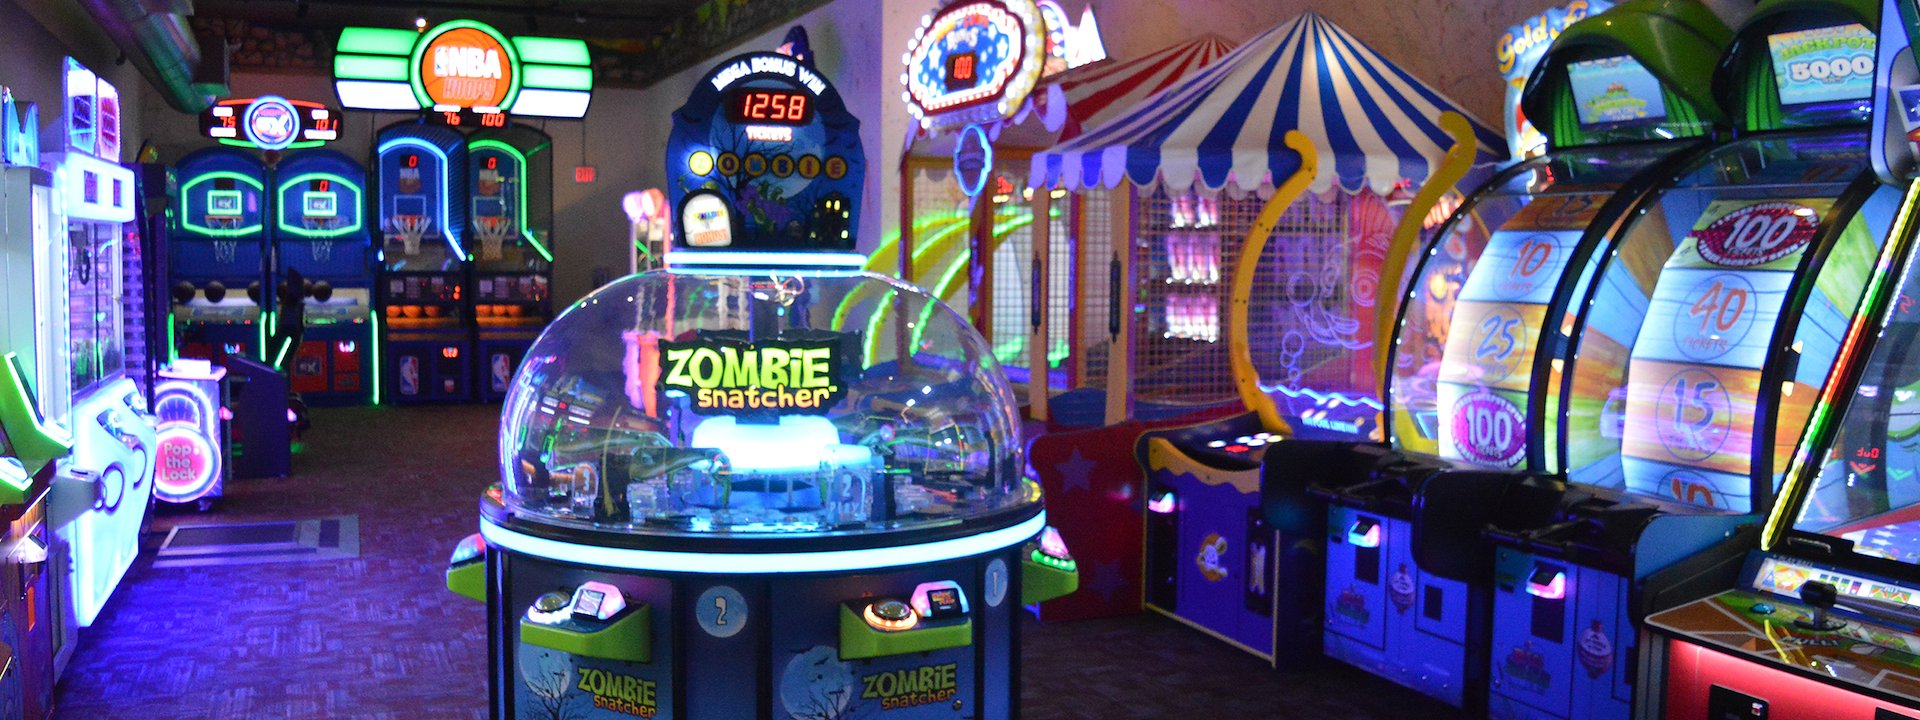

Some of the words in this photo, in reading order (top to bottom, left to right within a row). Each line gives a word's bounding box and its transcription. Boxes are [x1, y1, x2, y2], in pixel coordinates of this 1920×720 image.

[1497, 15, 1549, 74] Gold
[1782, 36, 1876, 59] JACKPOT
[447, 46, 502, 79] NBA
[711, 60, 752, 92] MEGA
[750, 56, 798, 77] BONUS
[797, 65, 827, 96] WIN
[1791, 56, 1875, 80] 5000
[442, 77, 497, 101] HOOPS
[443, 111, 461, 126] 76
[481, 112, 506, 127] 100
[743, 93, 806, 120] 1258
[745, 125, 793, 142] TICKETS
[409, 155, 418, 168] 0
[487, 156, 497, 170] 0
[694, 152, 845, 178] ZOMBIE
[319, 180, 328, 192] 0
[1723, 213, 1798, 250] 100
[1509, 238, 1553, 280] 10
[1689, 280, 1748, 335] 40
[1475, 314, 1521, 362] 25
[665, 347, 831, 389] ZOMBIE
[1673, 378, 1719, 433] 15
[1465, 403, 1513, 452] 100
[163, 441, 192, 457] Pop
[166, 456, 191, 468] the
[161, 467, 197, 480] Lock
[714, 595, 728, 625] 2
[577, 667, 656, 707] ZOMBIE
[862, 663, 957, 699] ZOMBIE
[593, 693, 656, 720] snatcher
[881, 688, 956, 712] snatcher
